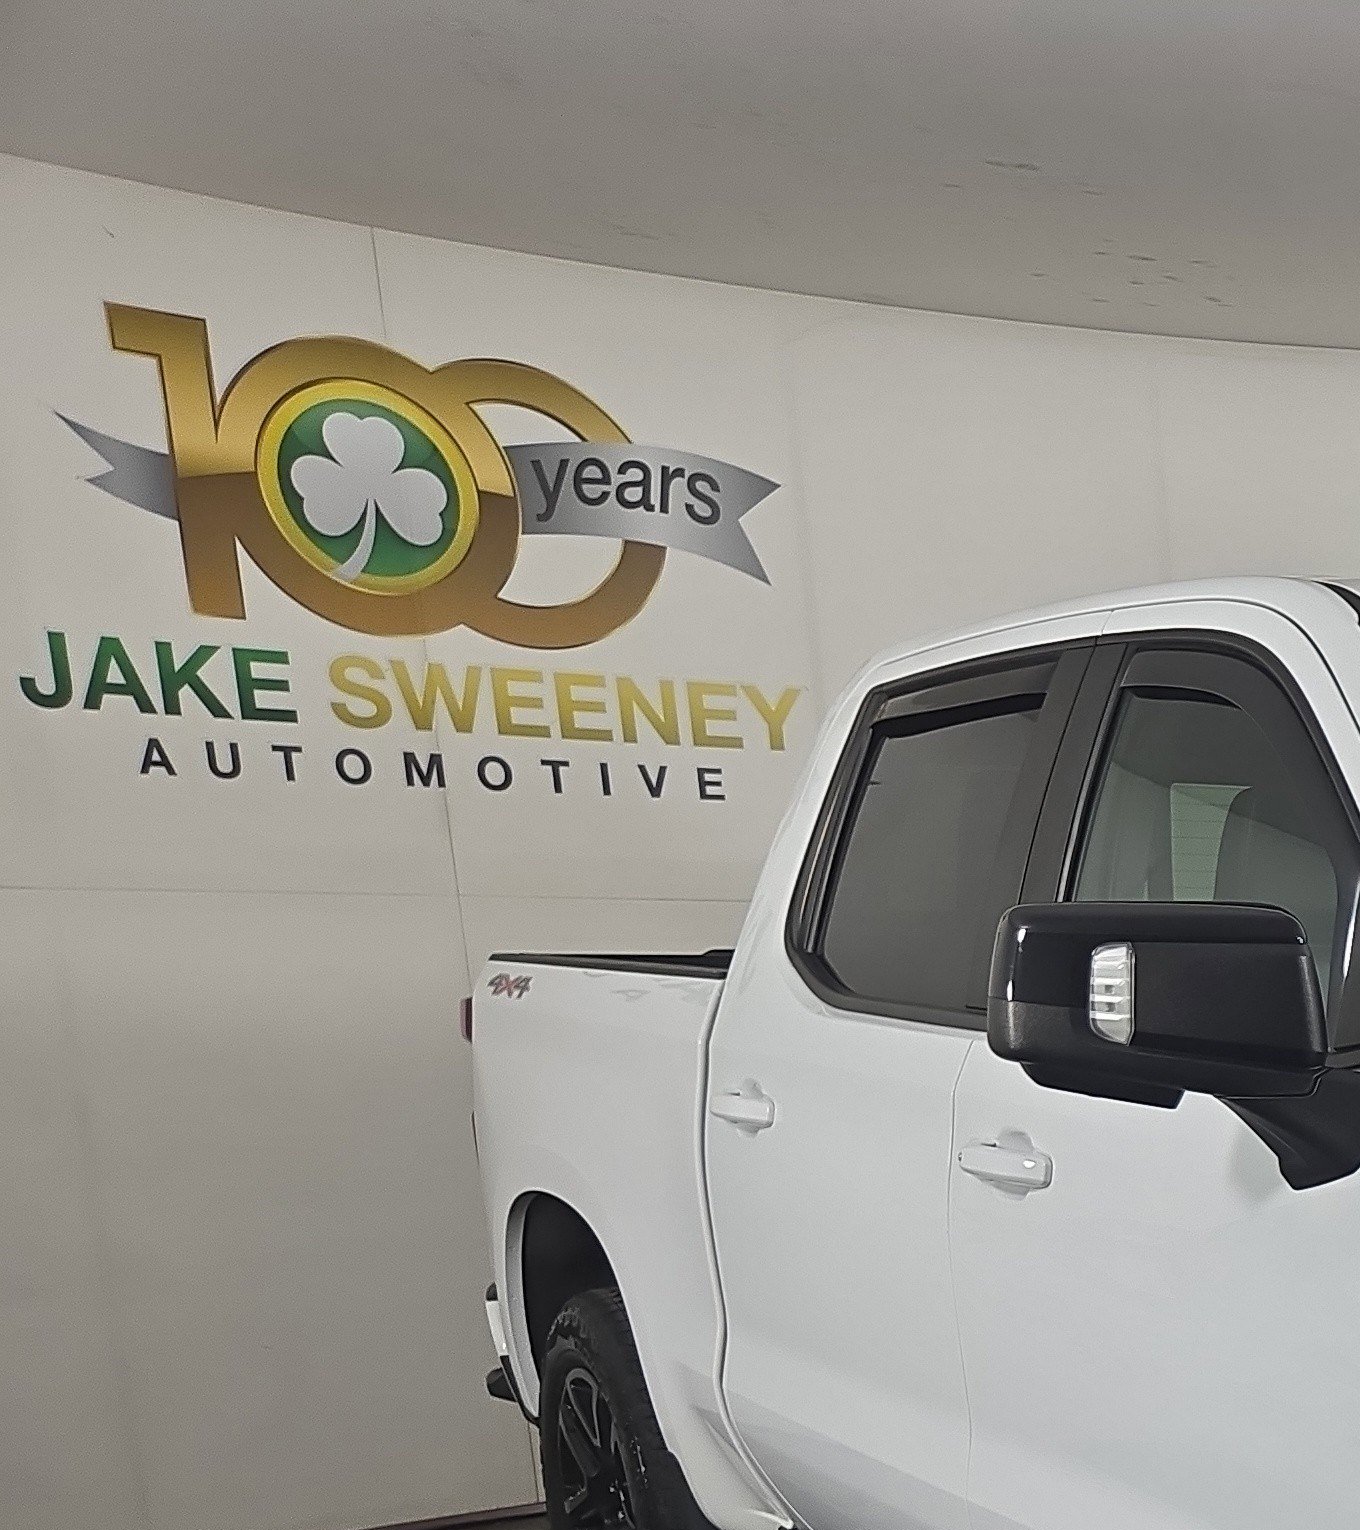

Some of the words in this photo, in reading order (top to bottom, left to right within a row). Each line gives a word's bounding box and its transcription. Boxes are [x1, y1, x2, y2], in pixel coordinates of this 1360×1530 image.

[105, 301, 667, 650] 100
[531, 452, 722, 525] years
[19, 630, 299, 724] JAKE
[329, 655, 801, 752] SWEENEY
[139, 737, 728, 802] AUTOMOTIVE
